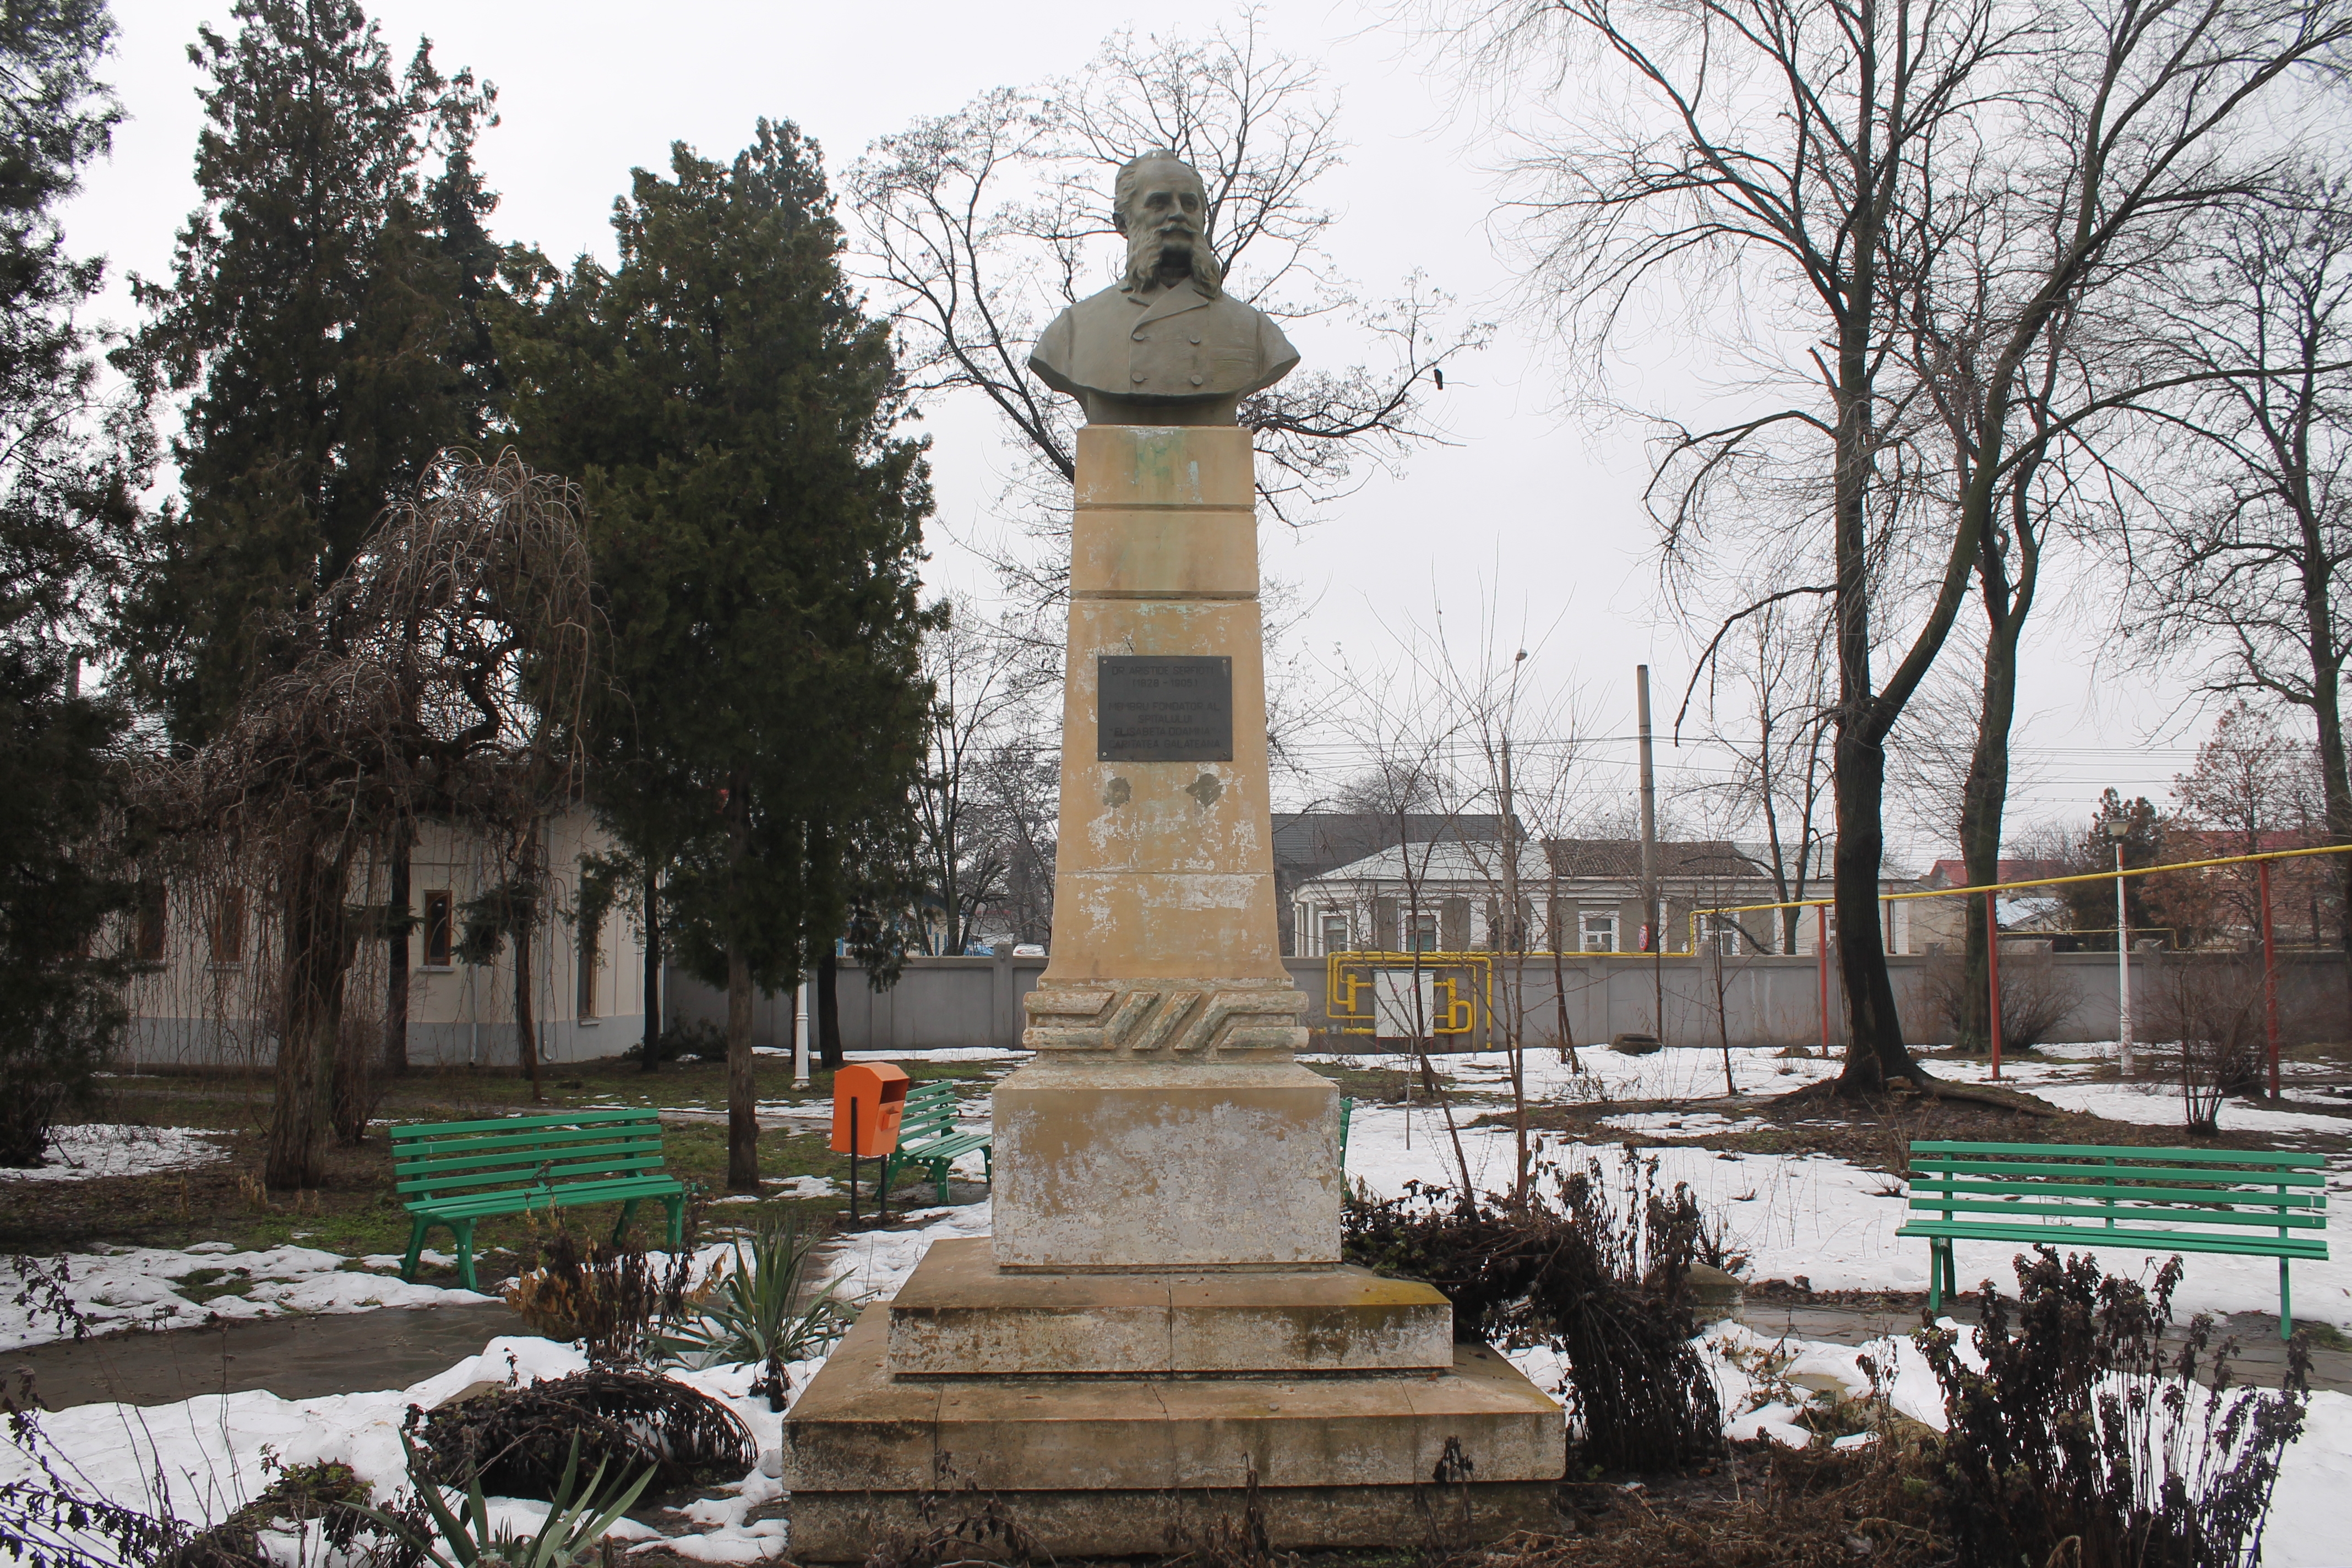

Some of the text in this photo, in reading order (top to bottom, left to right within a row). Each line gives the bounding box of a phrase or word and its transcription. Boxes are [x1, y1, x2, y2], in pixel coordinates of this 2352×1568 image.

[1111, 666, 1214, 675] DR ARISTIDE SERFIOTI
[1108, 701, 1220, 711] MEMBRU FONDATOR AL
[1137, 714, 1193, 723] SPITALULUI
[1108, 739, 1221, 749] CARITATEA GALATEANA
